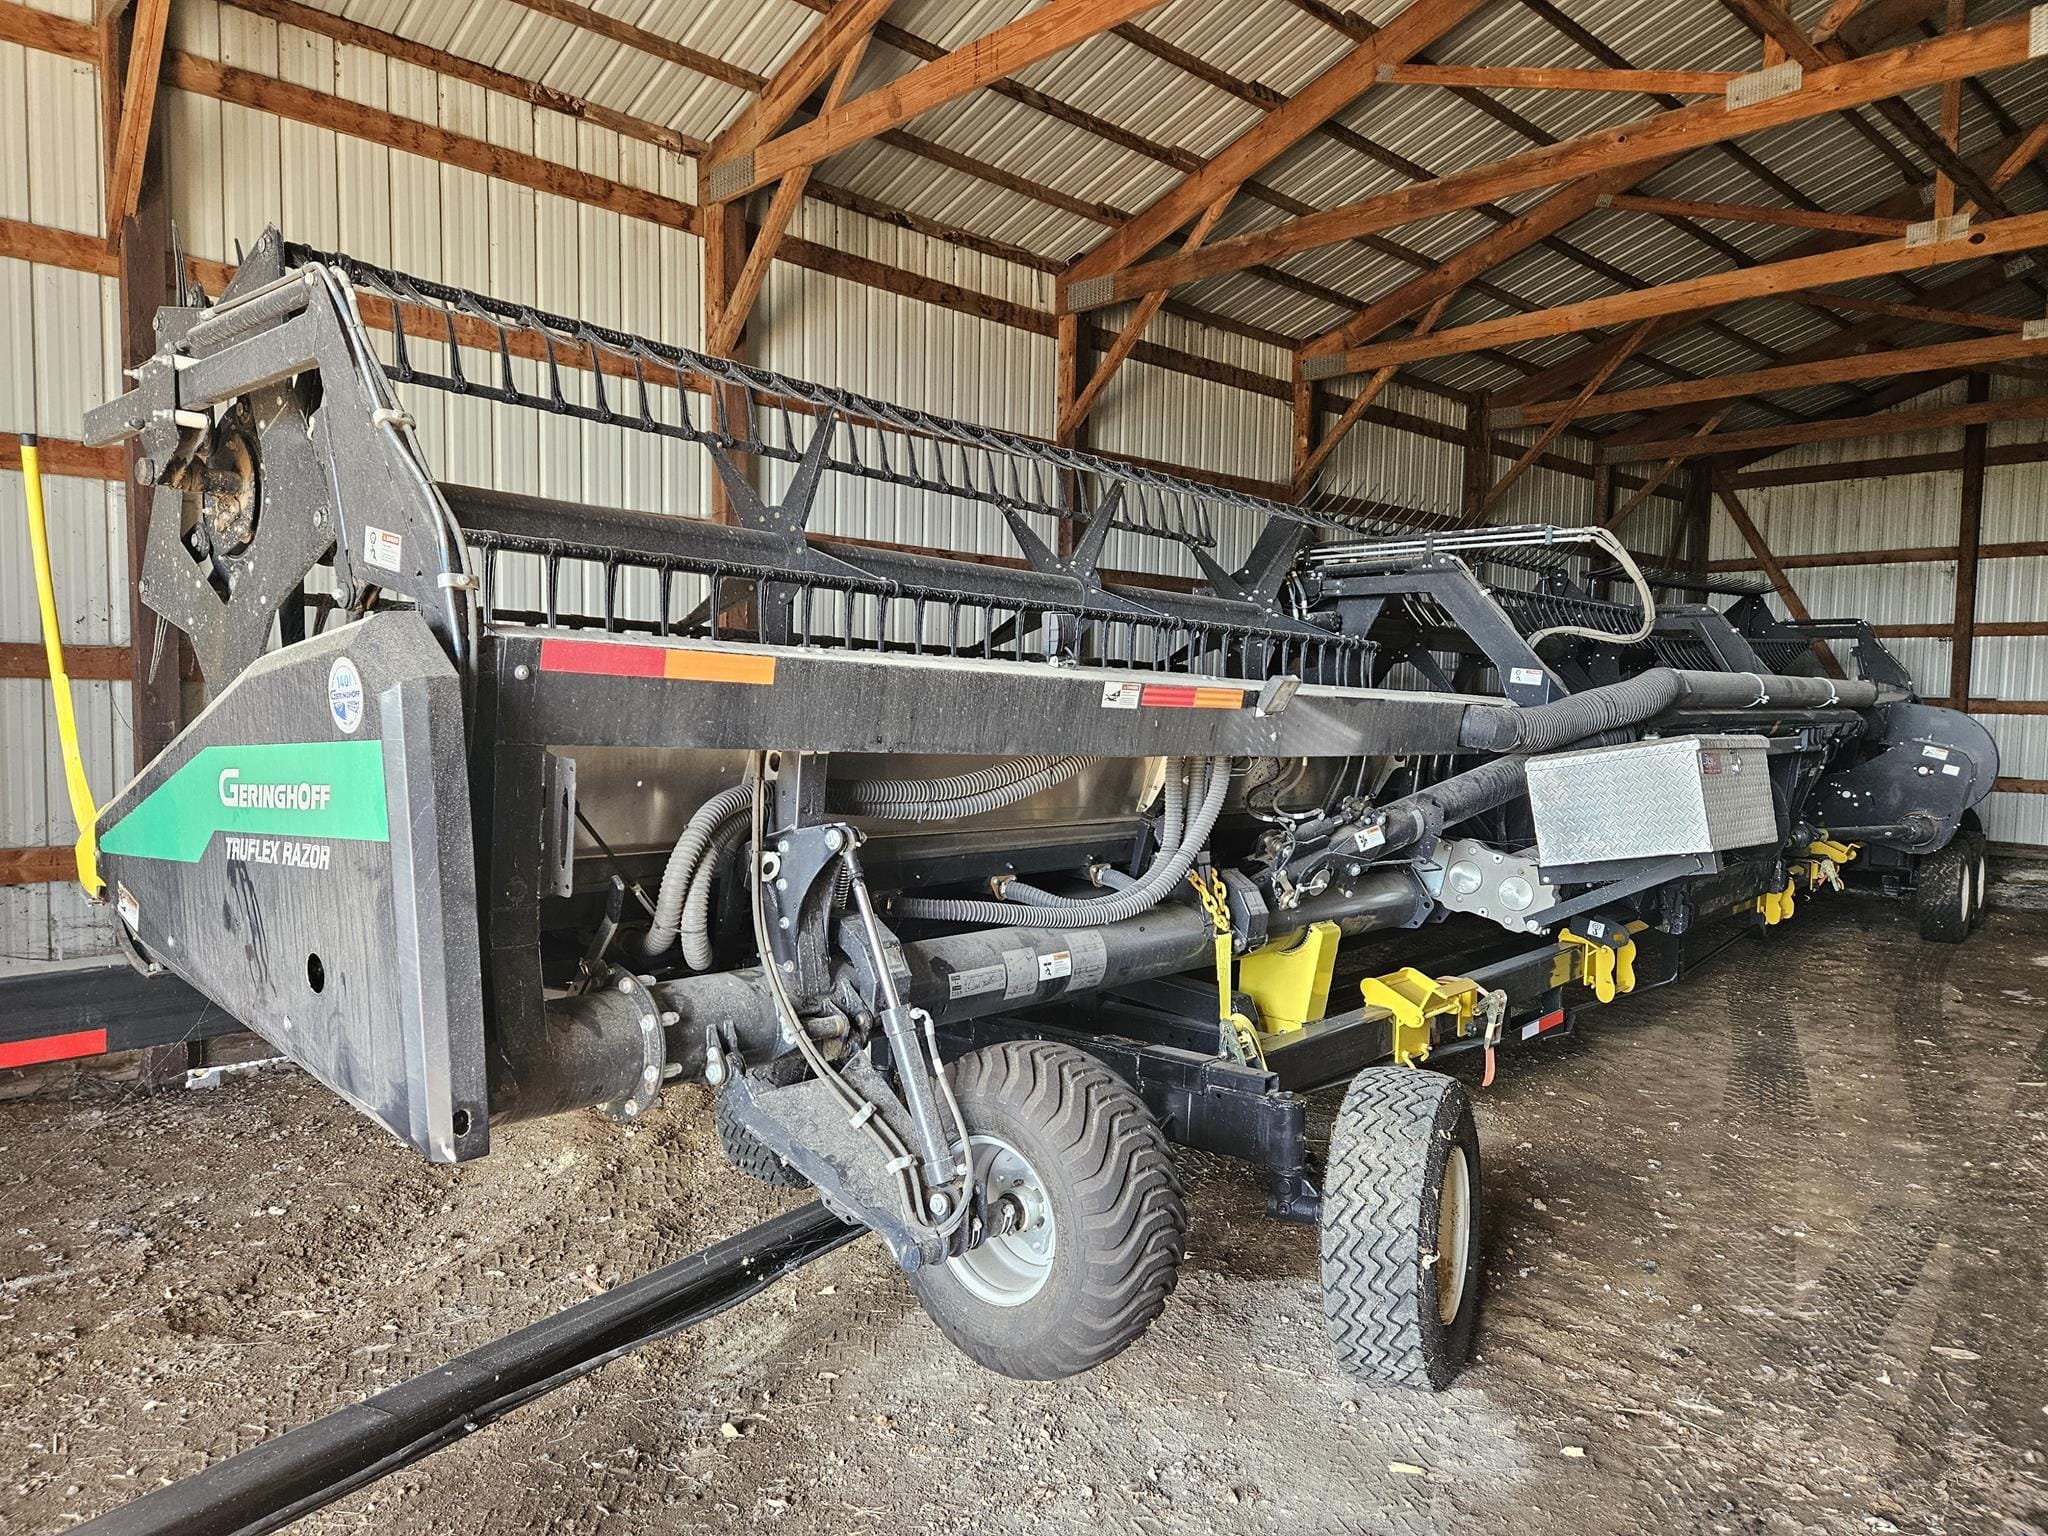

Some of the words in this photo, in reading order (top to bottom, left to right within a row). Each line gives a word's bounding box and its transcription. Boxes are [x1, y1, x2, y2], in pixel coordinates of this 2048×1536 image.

[218, 768, 331, 811] GERINGHOFF
[225, 837, 281, 865] TRUFLEX
[282, 841, 331, 871] RAZOR
